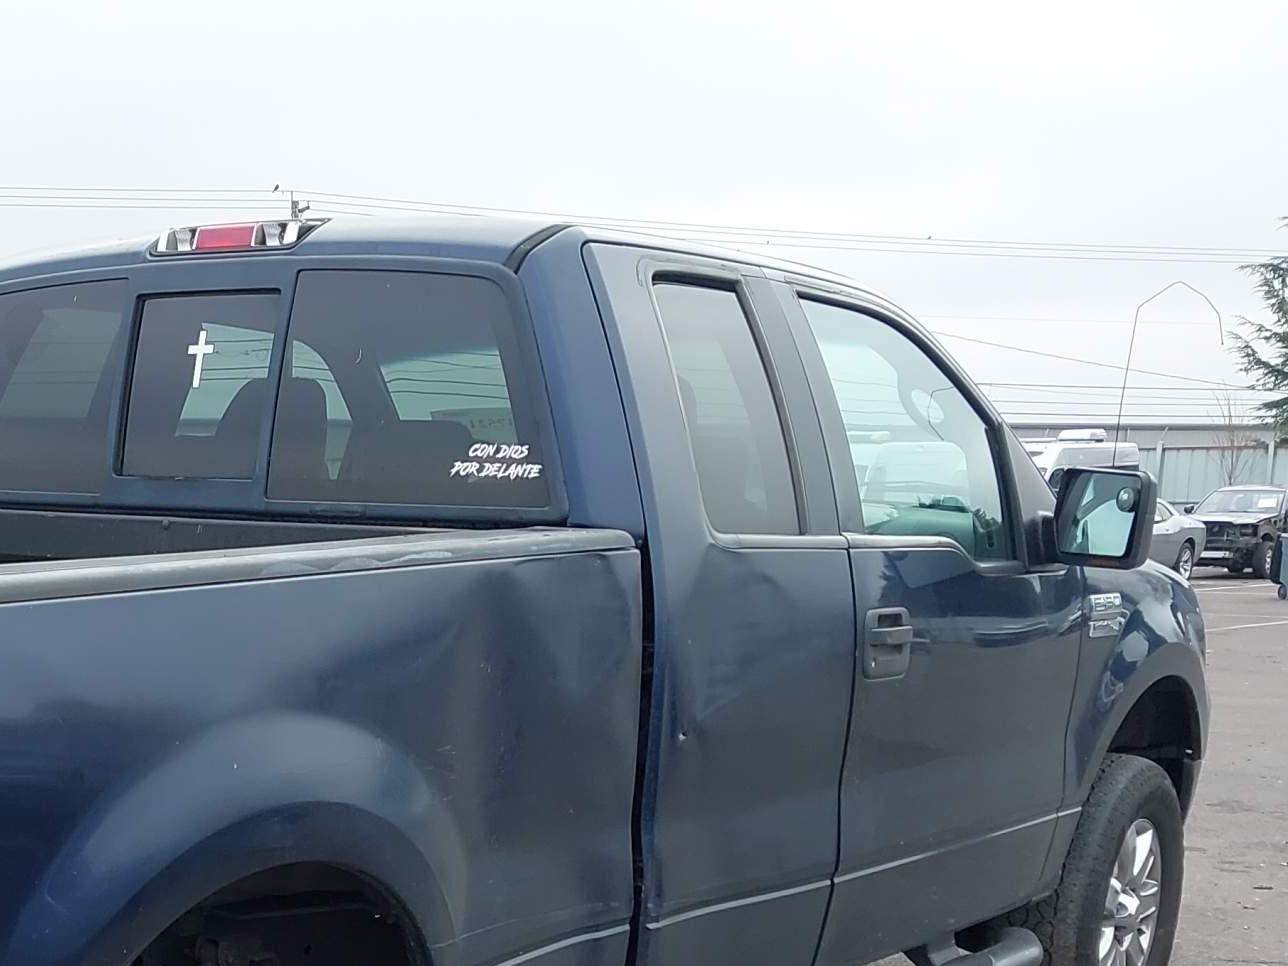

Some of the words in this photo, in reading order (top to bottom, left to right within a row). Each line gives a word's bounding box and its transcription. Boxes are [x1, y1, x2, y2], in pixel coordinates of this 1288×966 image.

[468, 442, 497, 459] CON
[496, 443, 530, 459] DIOS
[449, 460, 480, 477] POR
[479, 462, 543, 480] DELANTE
